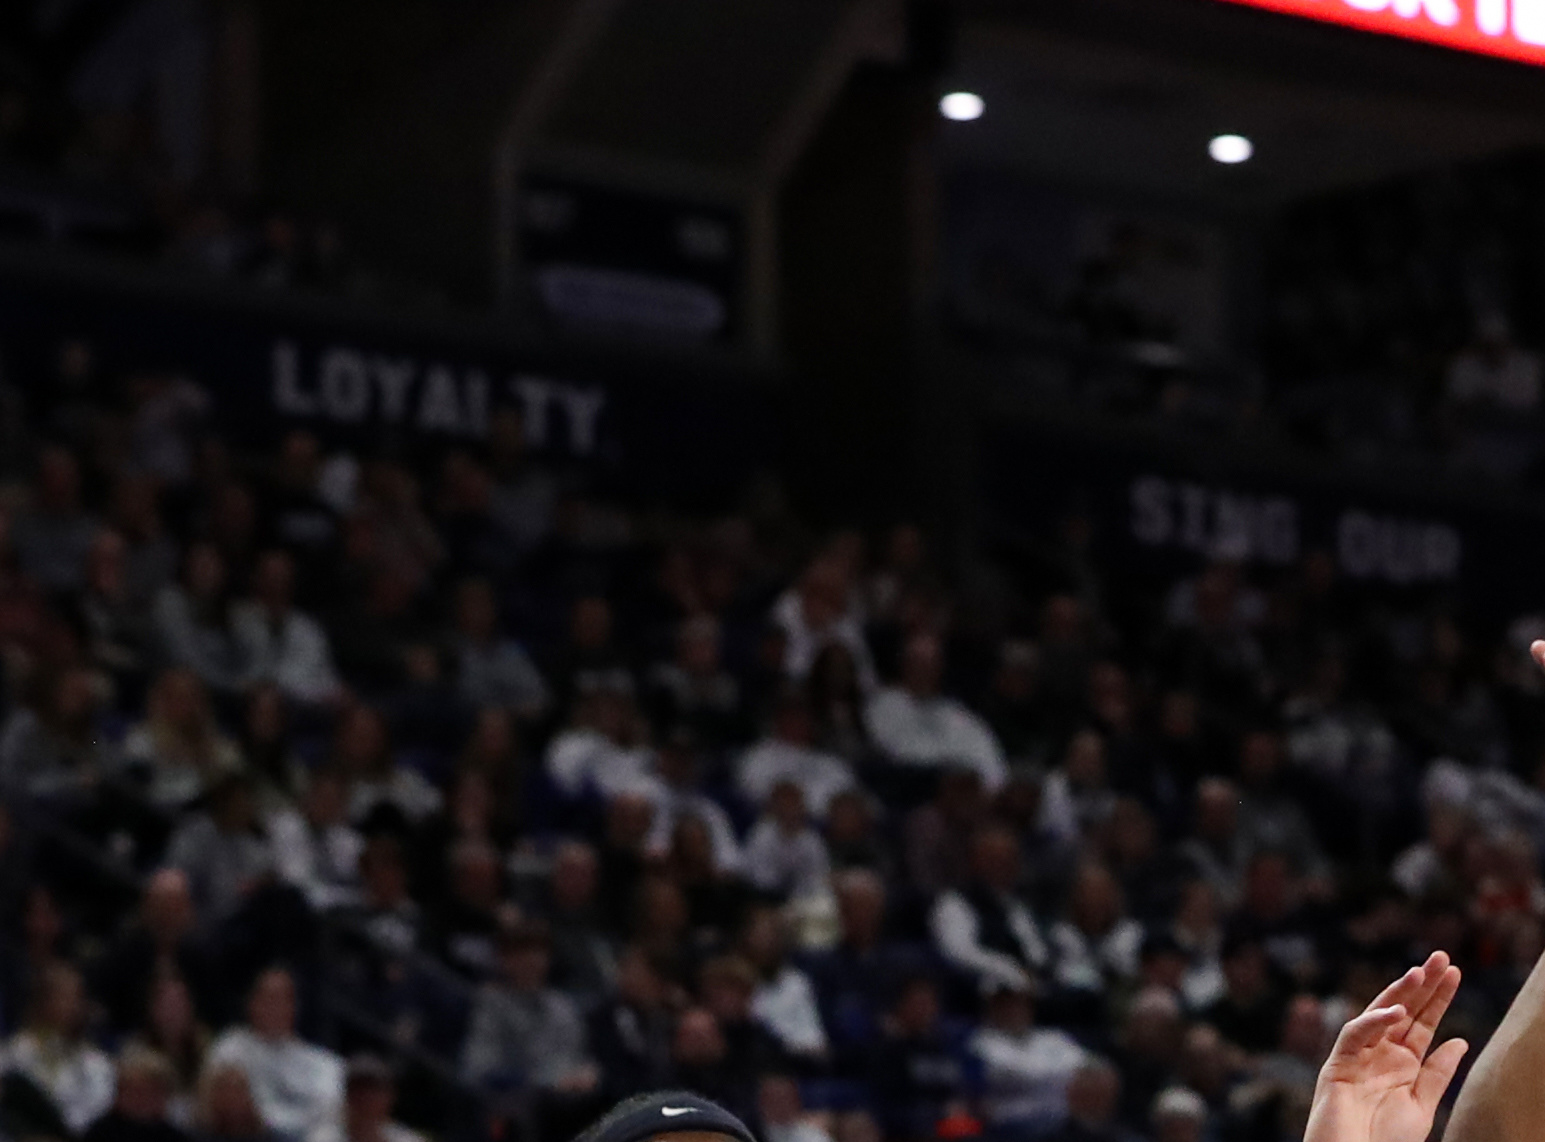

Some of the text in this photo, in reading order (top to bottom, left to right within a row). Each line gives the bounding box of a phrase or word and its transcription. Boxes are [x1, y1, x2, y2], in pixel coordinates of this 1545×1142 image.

[272, 338, 605, 457] LOYALTY
[1130, 474, 1462, 584] SING OUR
